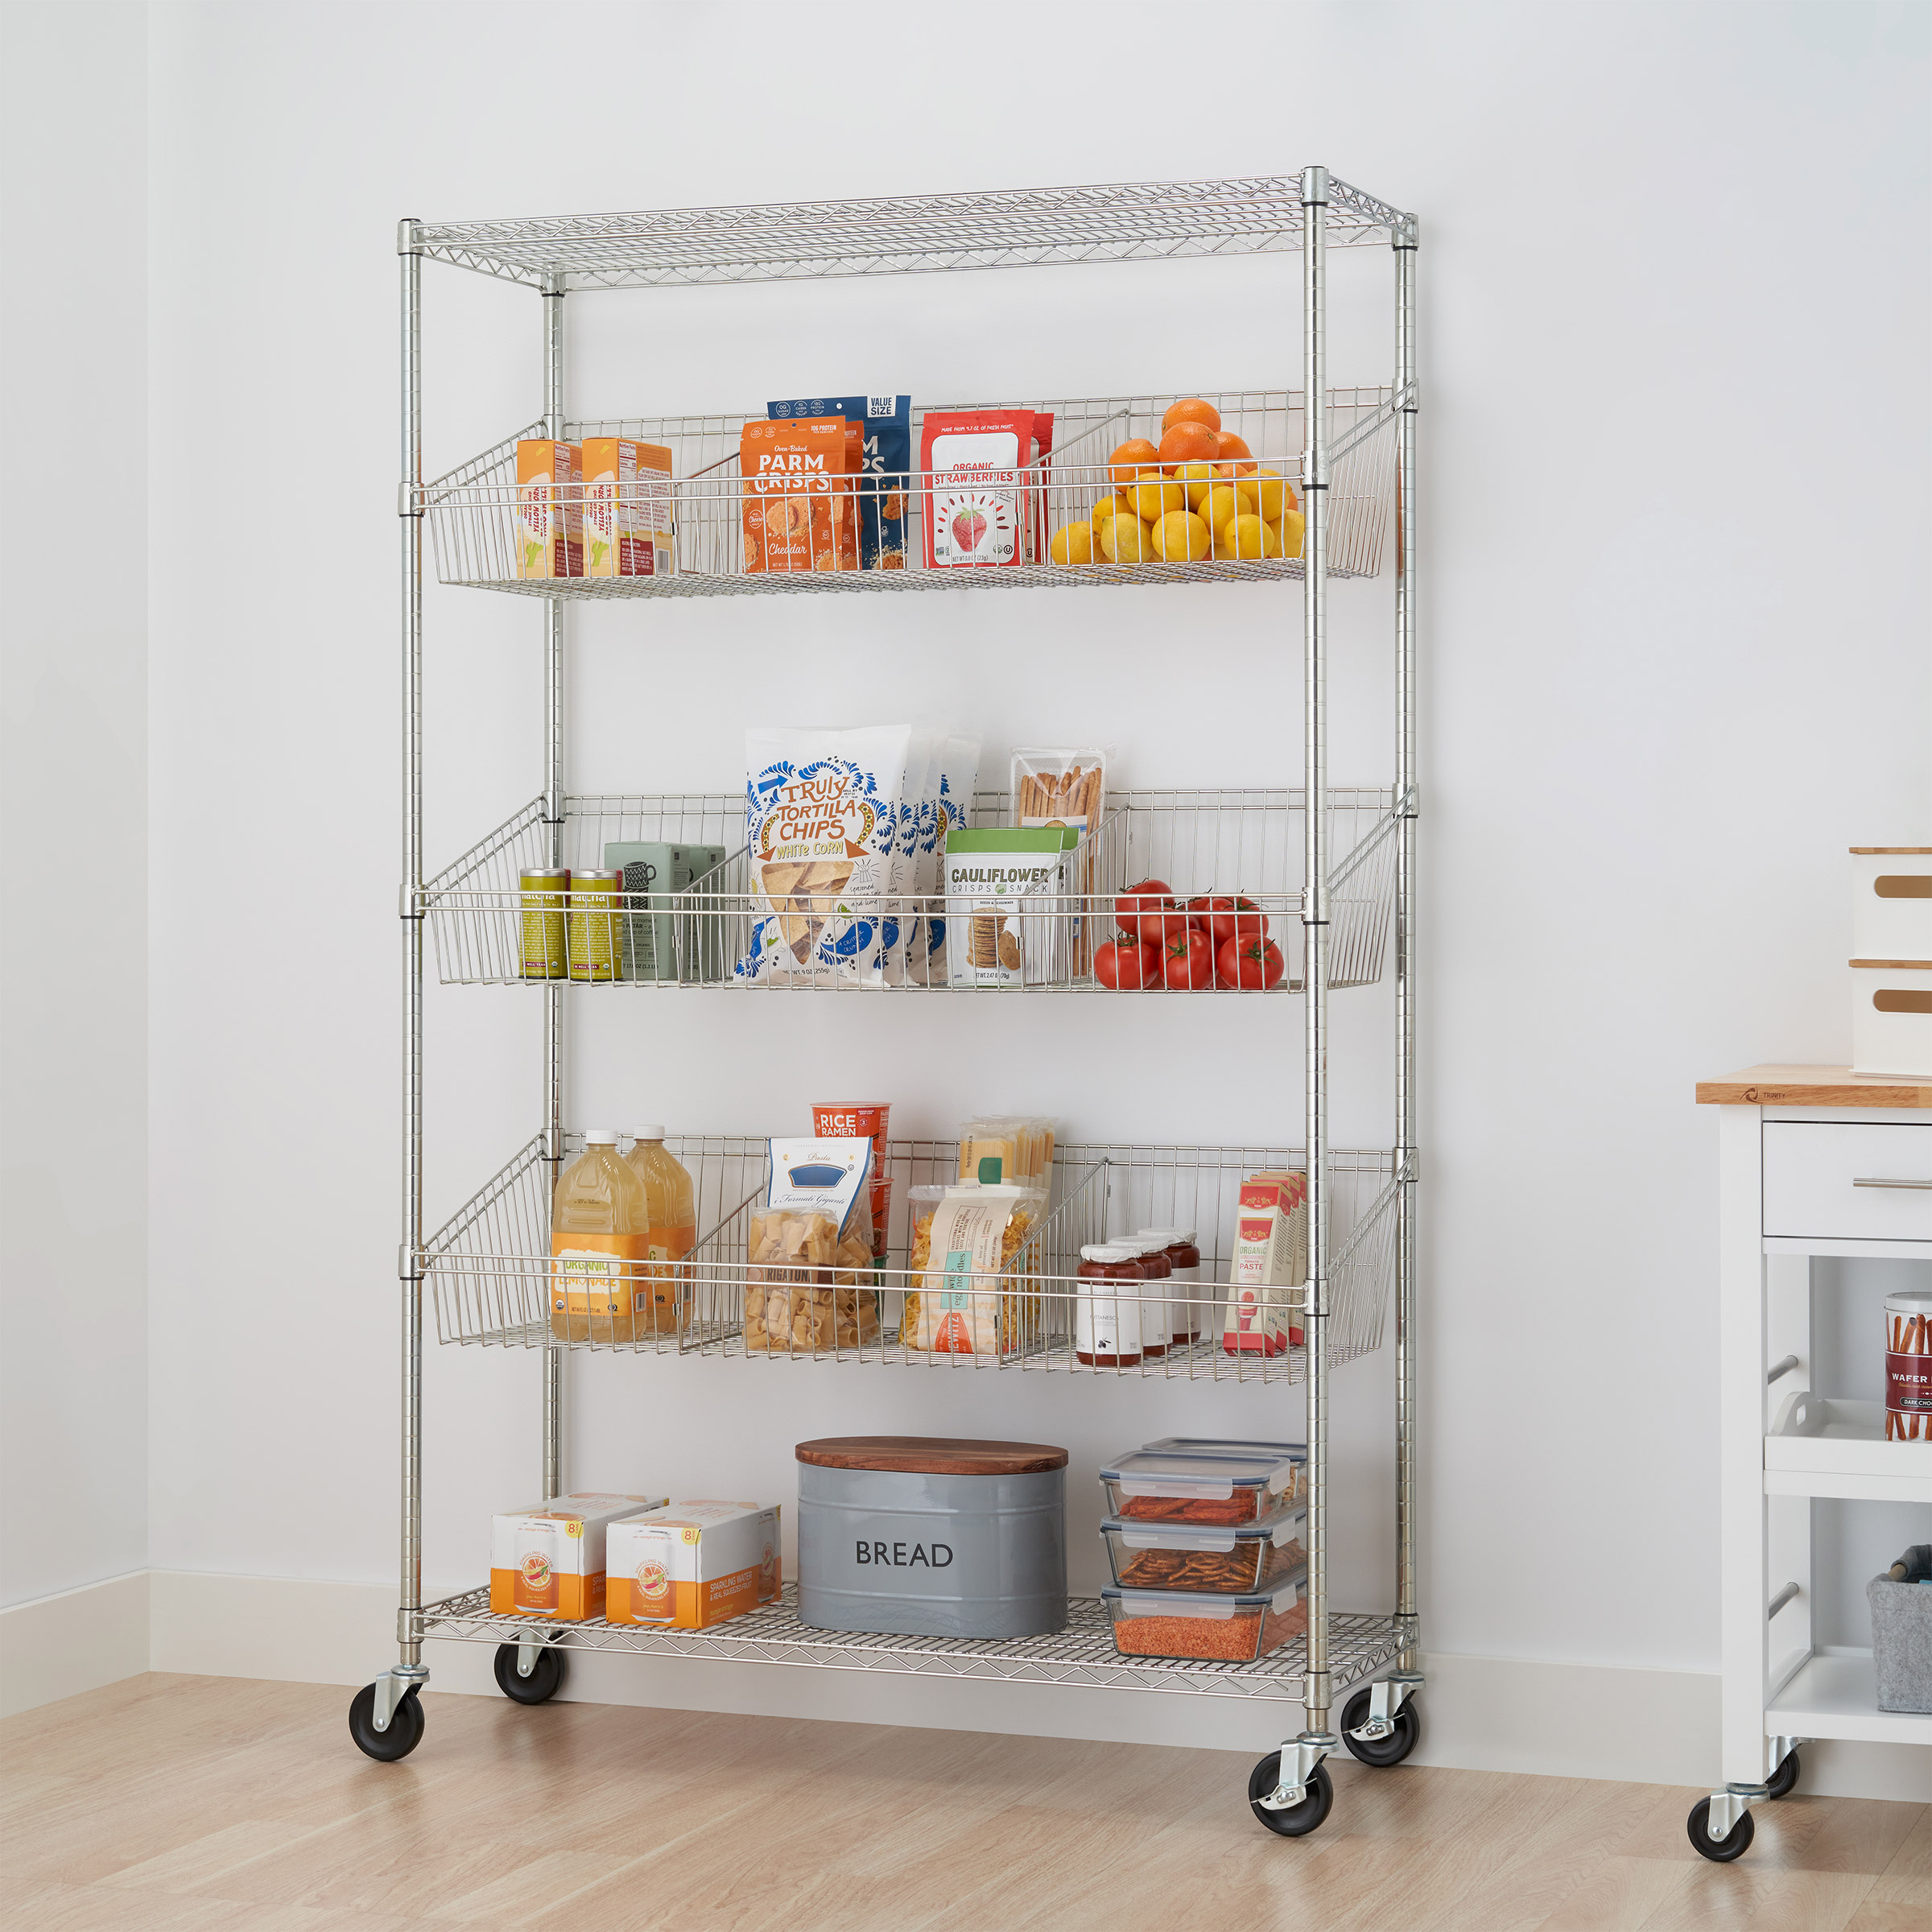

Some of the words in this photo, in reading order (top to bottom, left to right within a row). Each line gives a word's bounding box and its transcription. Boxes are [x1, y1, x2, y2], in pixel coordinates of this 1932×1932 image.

[871, 397, 892, 407] VALUE
[871, 407, 892, 415] SIZE
[774, 444, 807, 452] Oven-Baked
[759, 454, 824, 471] PARM
[953, 462, 994, 470] ORGANIC
[754, 471, 830, 493] CRISPS
[777, 799, 856, 821] TORTILLA
[780, 819, 845, 841] CHIPS
[952, 868, 1049, 883] CAULIFLOWER
[952, 885, 992, 893] CRISPS
[820, 1114, 856, 1127] RICE
[821, 1128, 856, 1136] RAMEN
[807, 1152, 831, 1162] Pasta
[811, 1194, 848, 1208] Giganti
[1240, 1246, 1267, 1254] ORGANIC
[565, 1261, 608, 1271] ORGANIC
[956, 1253, 966, 1286] nodles
[767, 1268, 811, 1282] RIGATON
[955, 1290, 964, 1306] eg
[1892, 1373, 1928, 1383] WAFER
[568, 1523, 575, 1533] 8
[684, 1530, 691, 1540] 8
[519, 1550, 541, 1566] SPARKLING
[542, 1552, 554, 1568] WATER
[856, 1540, 954, 1569] BREAD
[658, 1560, 670, 1575] WATER
[710, 1575, 737, 1593] SPARKLING
[737, 1571, 753, 1583] WATER
[713, 1591, 723, 1600] REAL
[723, 1584, 741, 1597] SQUEEZED
[741, 1580, 752, 1591] FRUIT
